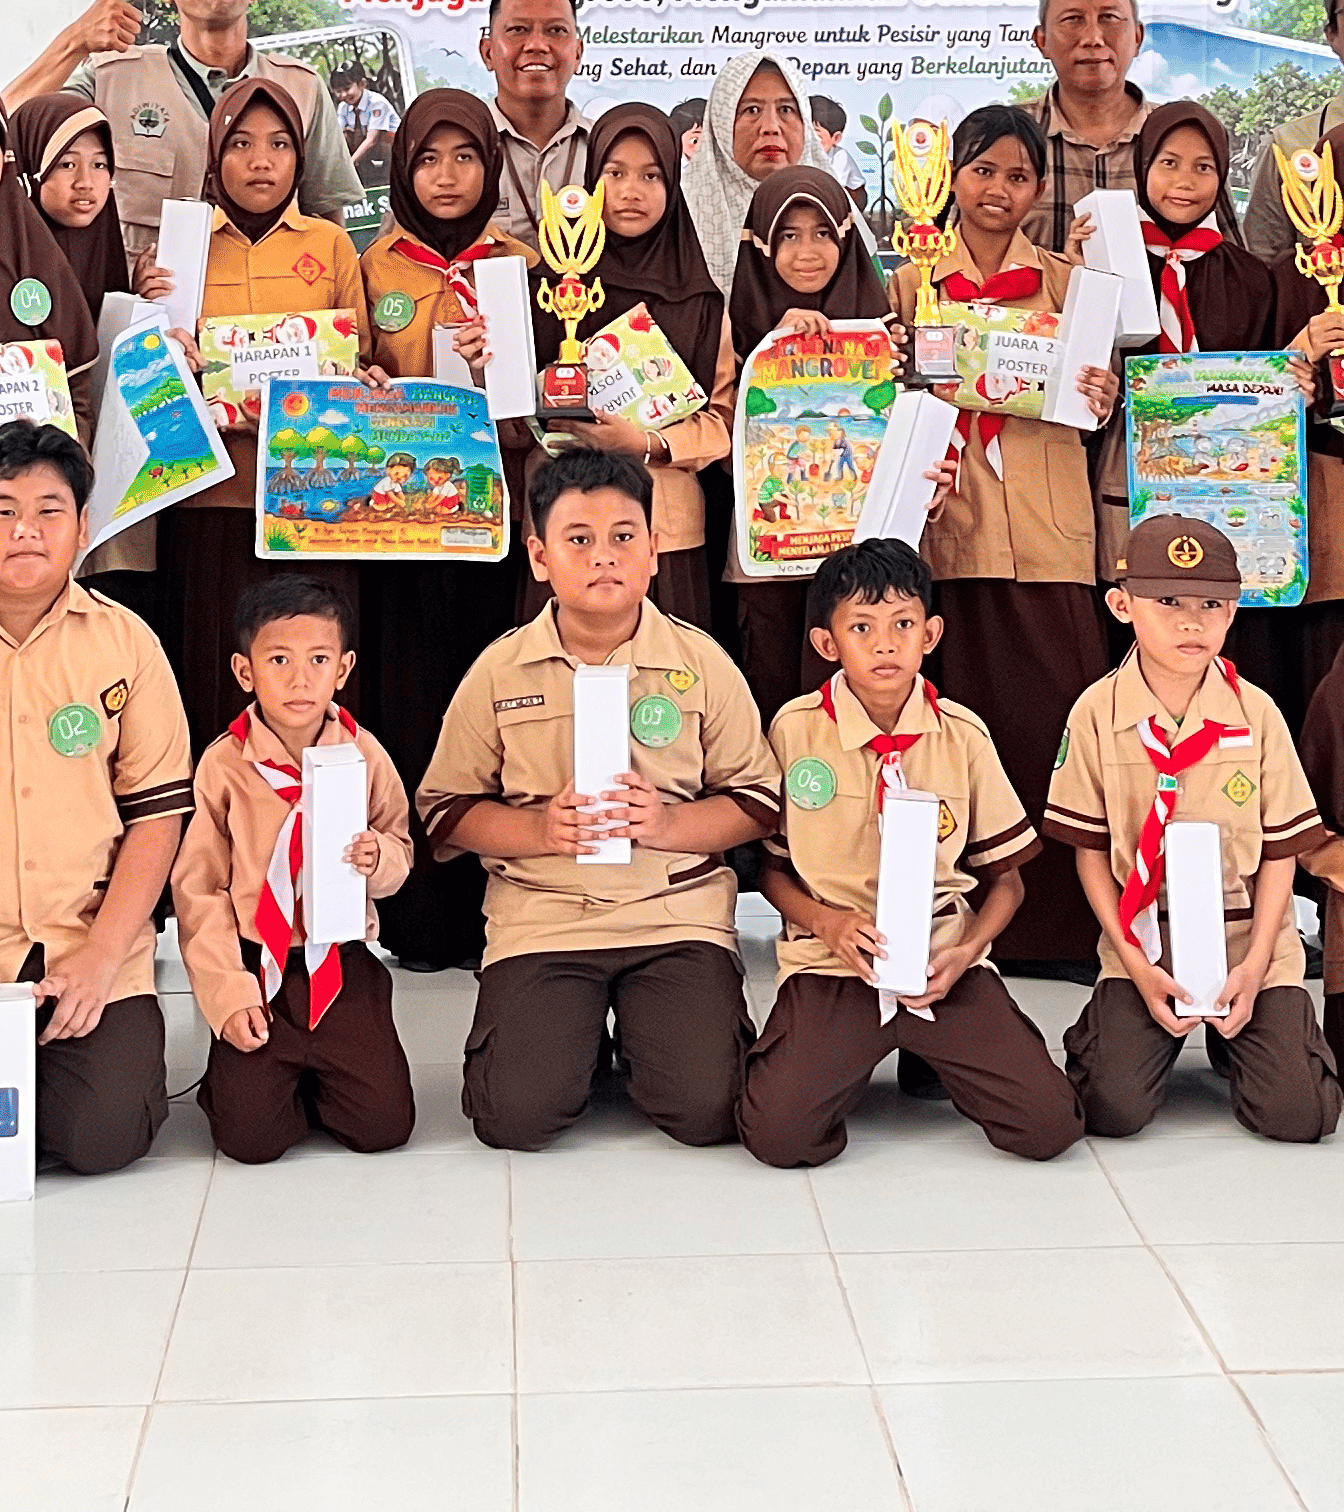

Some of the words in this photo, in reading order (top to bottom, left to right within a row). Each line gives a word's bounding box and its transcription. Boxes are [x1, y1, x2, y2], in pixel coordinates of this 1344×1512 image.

[711, 26, 807, 49] Mangrove
[814, 26, 871, 42] untuk
[878, 24, 940, 43] Pesisir
[946, 28, 991, 50] yang
[610, 57, 672, 77] Sehat,
[681, 59, 717, 76] dan
[857, 62, 902, 80] yang
[911, 55, 1052, 79] Berkelanjutan
[343, 198, 376, 219] nak
[21, 288, 41, 308] 04
[383, 297, 404, 317] 05
[234, 347, 299, 363] HARAPAN
[304, 345, 312, 356] 1
[995, 335, 1039, 351] JUARA
[1046, 342, 1055, 354] 2
[997, 357, 1048, 375] POSTER
[32, 380, 39, 392] 2
[560, 385, 570, 396] 3
[1207, 383, 1239, 393] MASA
[605, 386, 637, 412] JUAR
[57, 710, 88, 739] 02
[798, 768, 824, 792] 06
